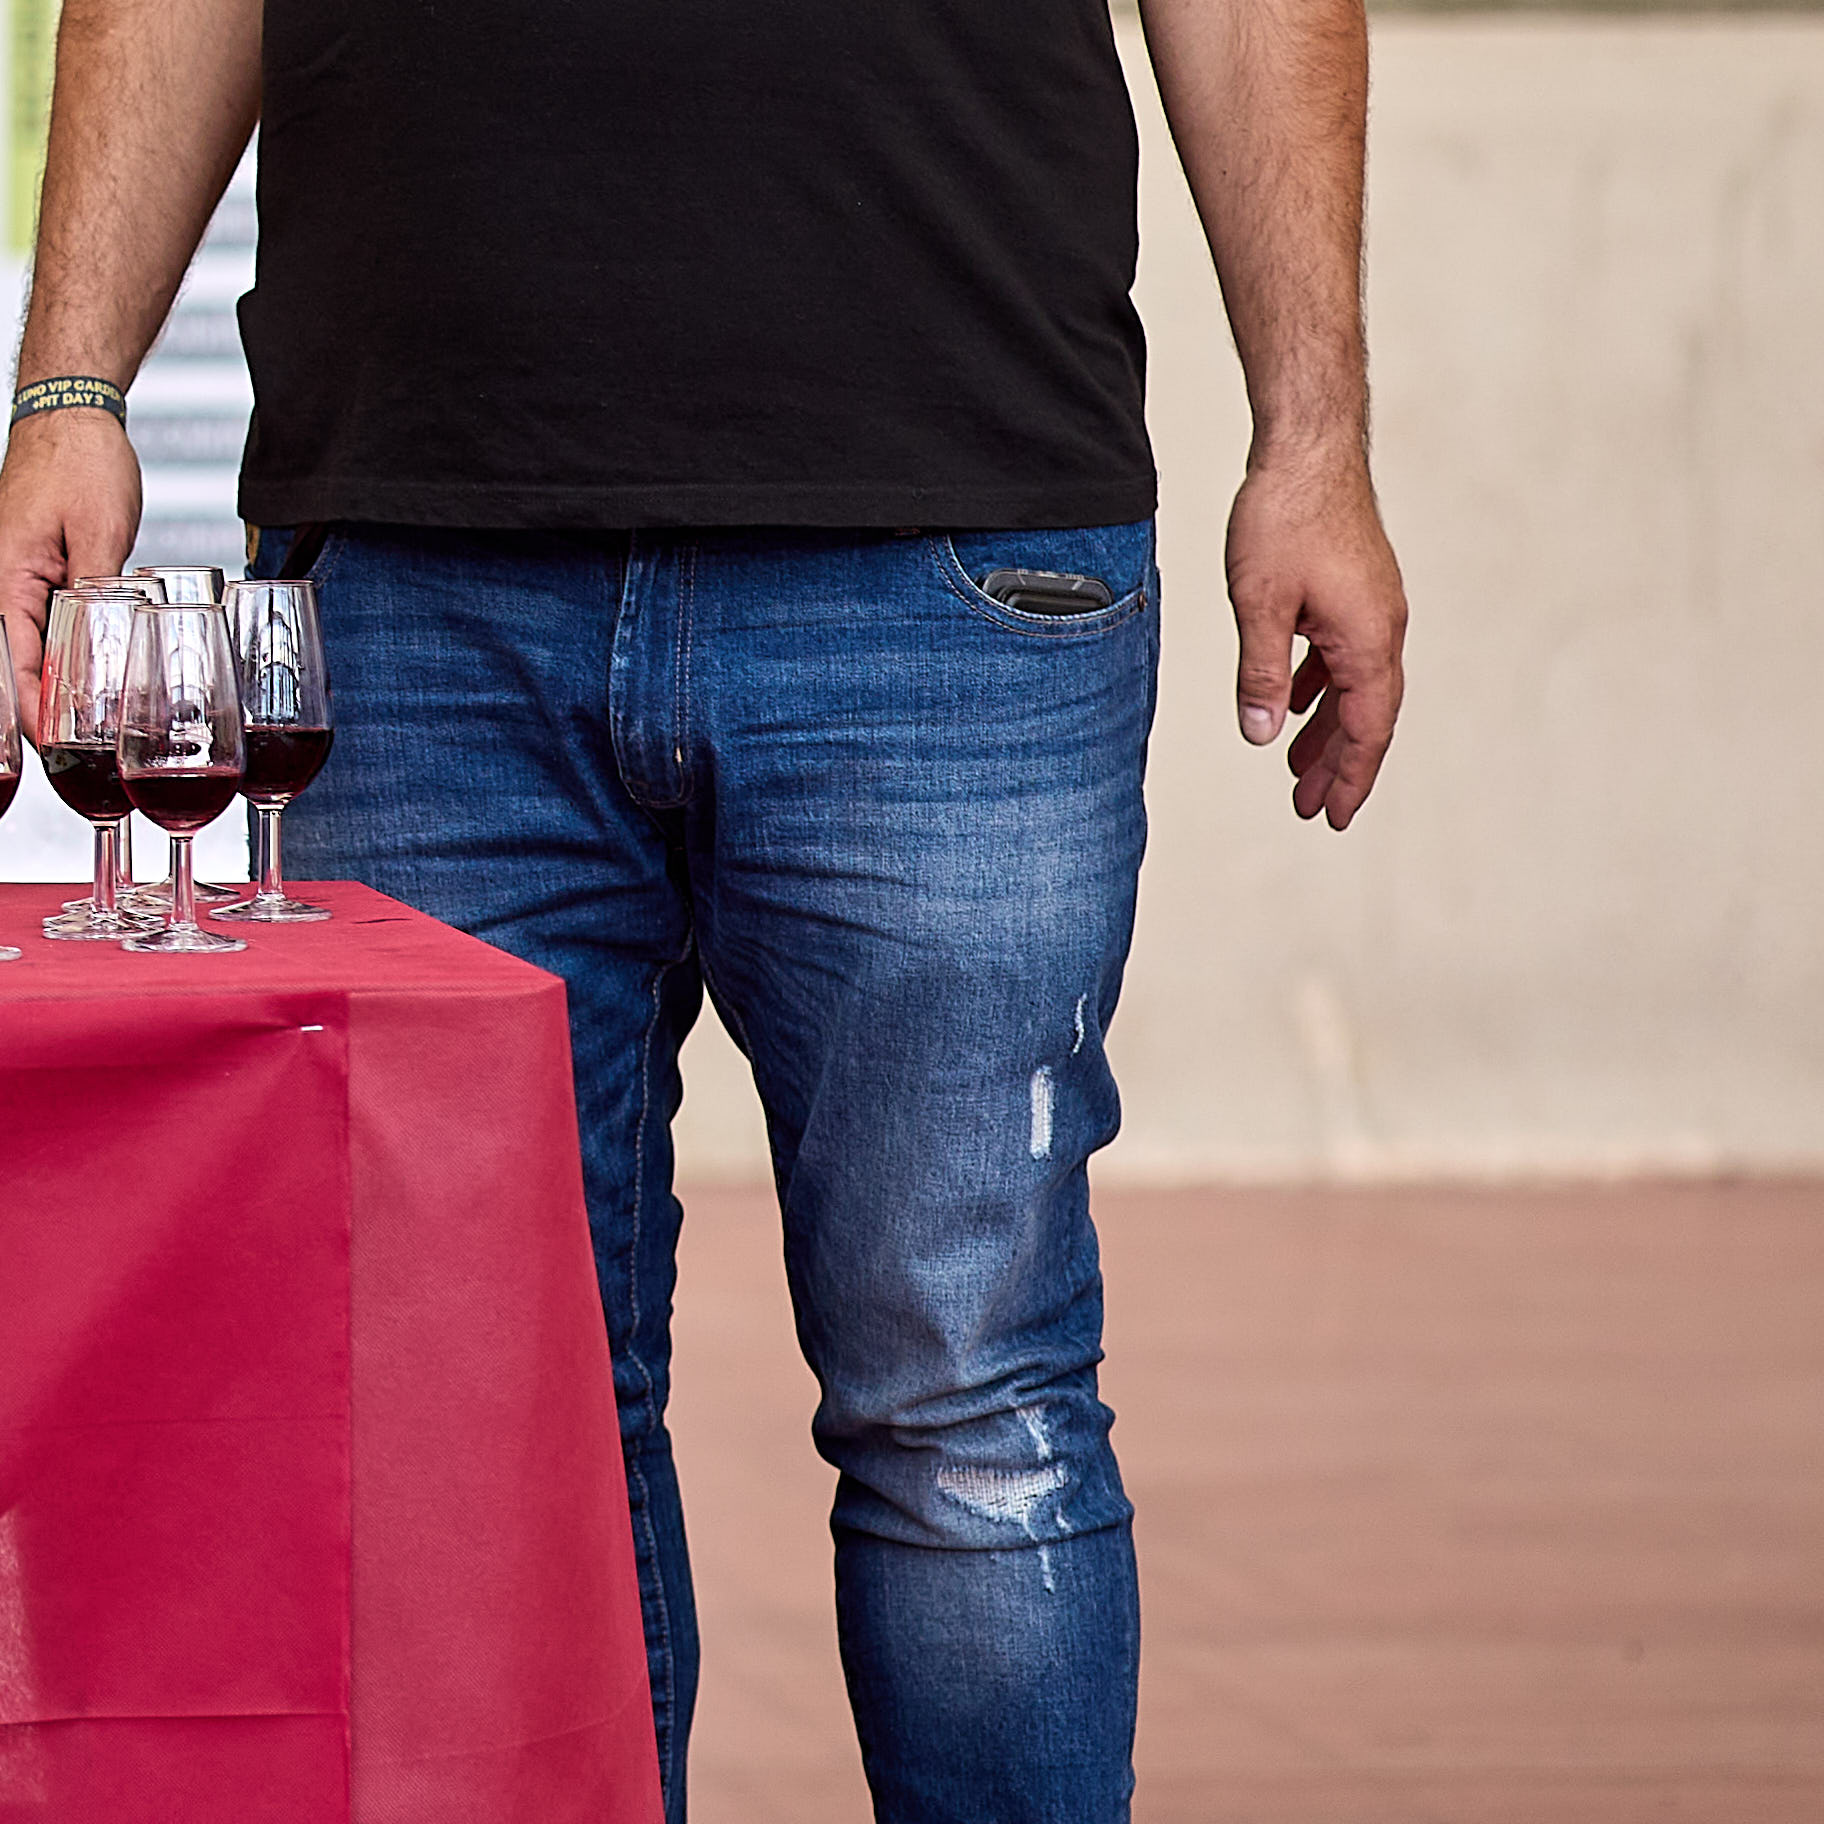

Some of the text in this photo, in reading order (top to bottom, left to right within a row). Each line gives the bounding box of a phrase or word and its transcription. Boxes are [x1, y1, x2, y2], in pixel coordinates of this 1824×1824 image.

[48, 379, 72, 394] VIP
[62, 392, 93, 406] DAY
[94, 395, 105, 406] 3
